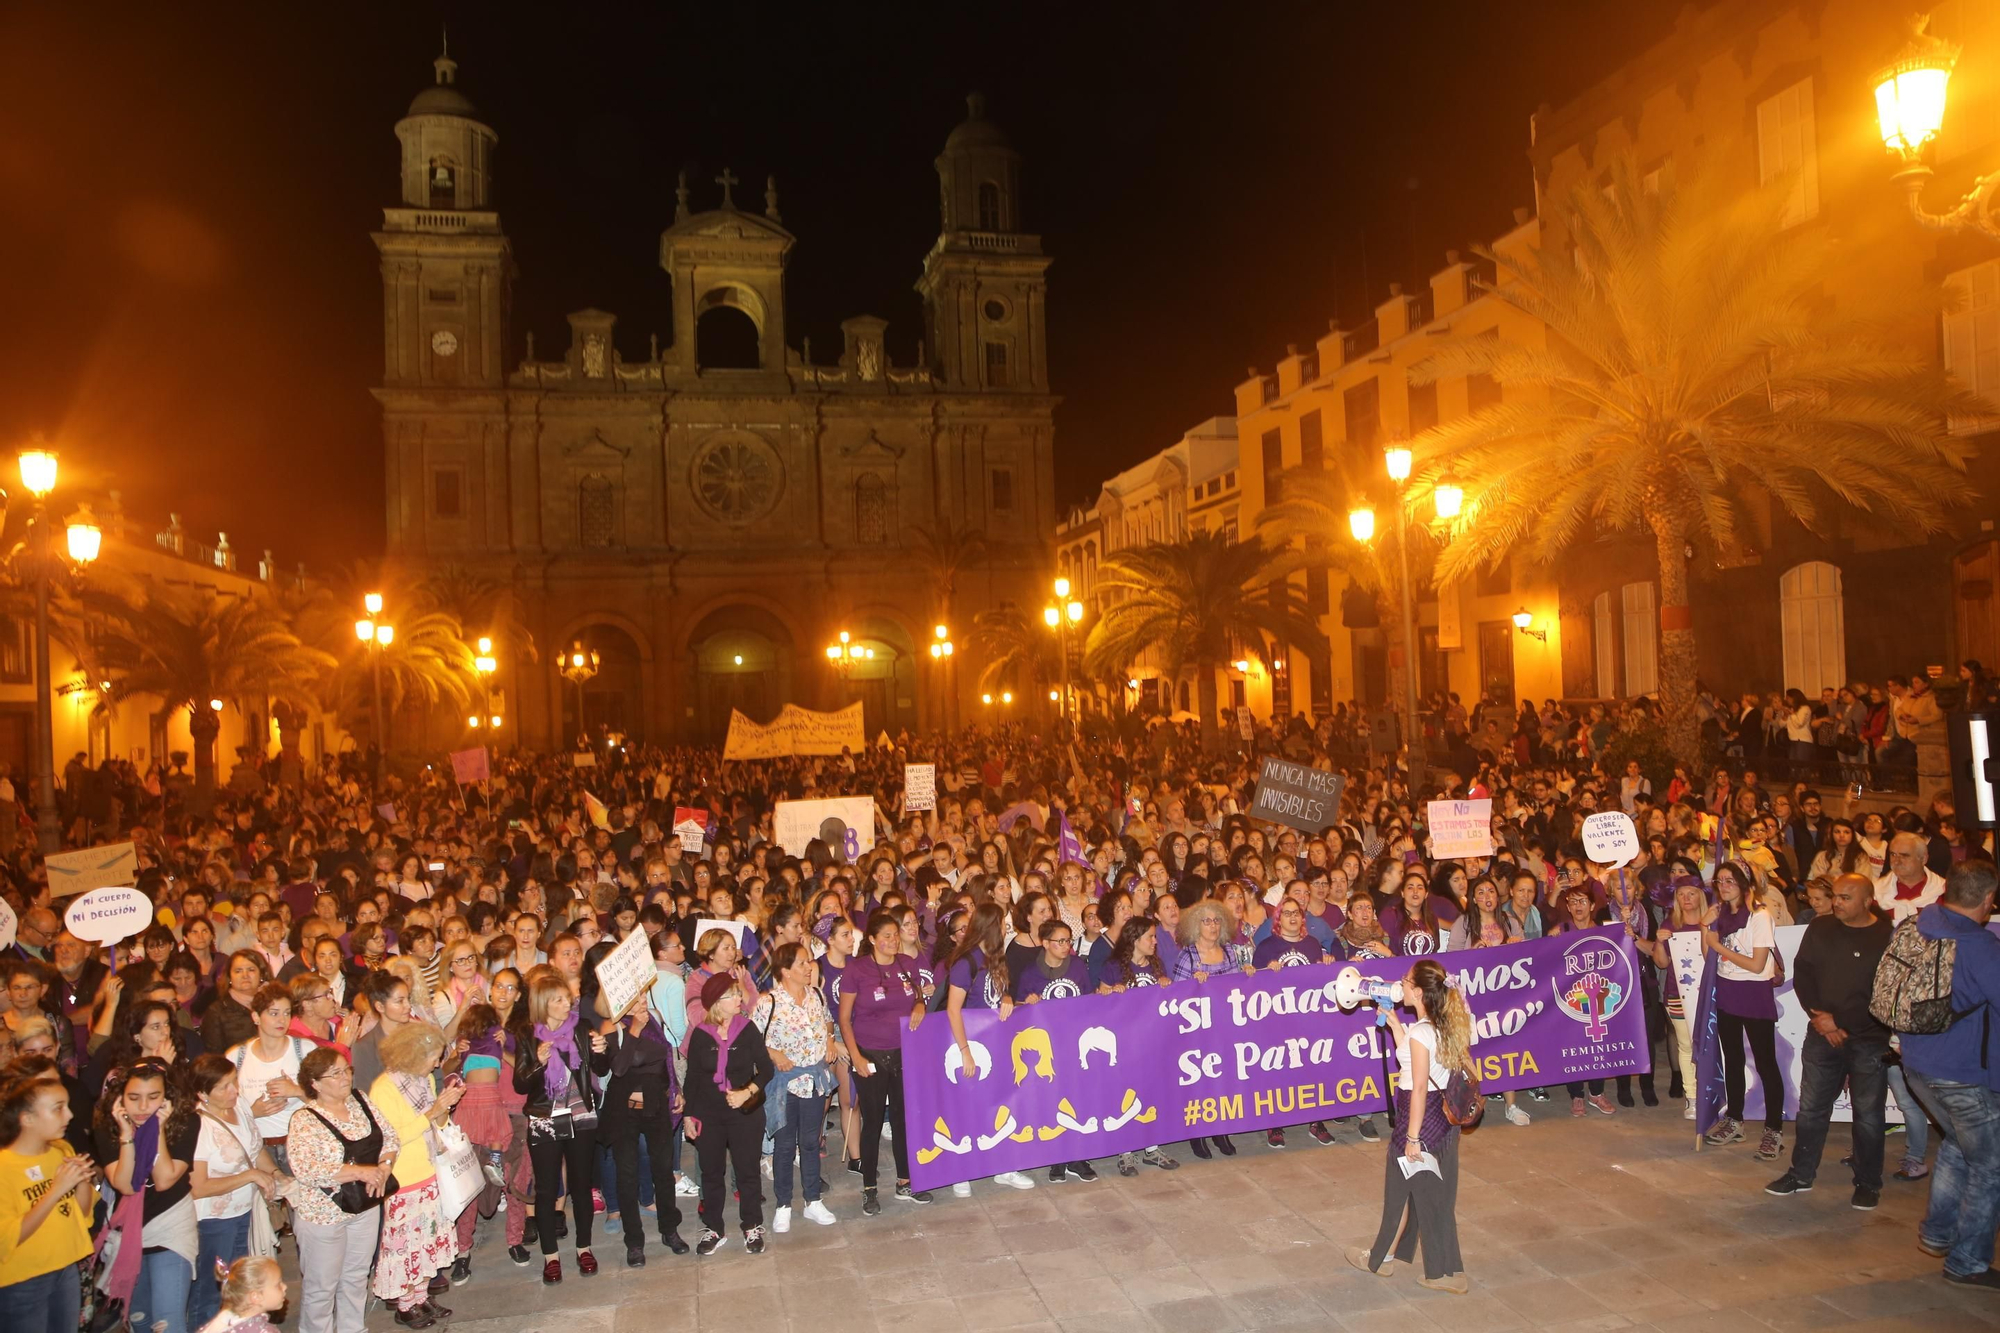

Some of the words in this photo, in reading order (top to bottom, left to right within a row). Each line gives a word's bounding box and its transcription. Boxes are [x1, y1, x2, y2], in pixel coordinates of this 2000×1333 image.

[1265, 761, 1304, 787] NUNCA
[1307, 772, 1337, 795] MÁS
[1260, 787, 1324, 822] INVISIBLES
[1430, 820, 1472, 831] ESTAMOS
[1587, 815, 1611, 823] QUIERO
[1596, 821, 1621, 830] LIBRE,
[1587, 829, 1625, 838] VALIENTE
[844, 827, 859, 859] 8
[1612, 840, 1627, 848] SOY
[56, 848, 117, 866] MACHETE
[60, 869, 126, 891] MACHOTE
[98, 893, 131, 903] CUERPO
[91, 904, 136, 920] DECISIÓN
[1565, 949, 1616, 976] RED
[1562, 1041, 1636, 1058] FEMINISTA
[1178, 1049, 1223, 1087] Se
[1564, 1064, 1590, 1074] GRAN
[1593, 1059, 1636, 1071] CANARIA
[1184, 1094, 1245, 1127] #8M
[1254, 1075, 1380, 1117] HUELGA
